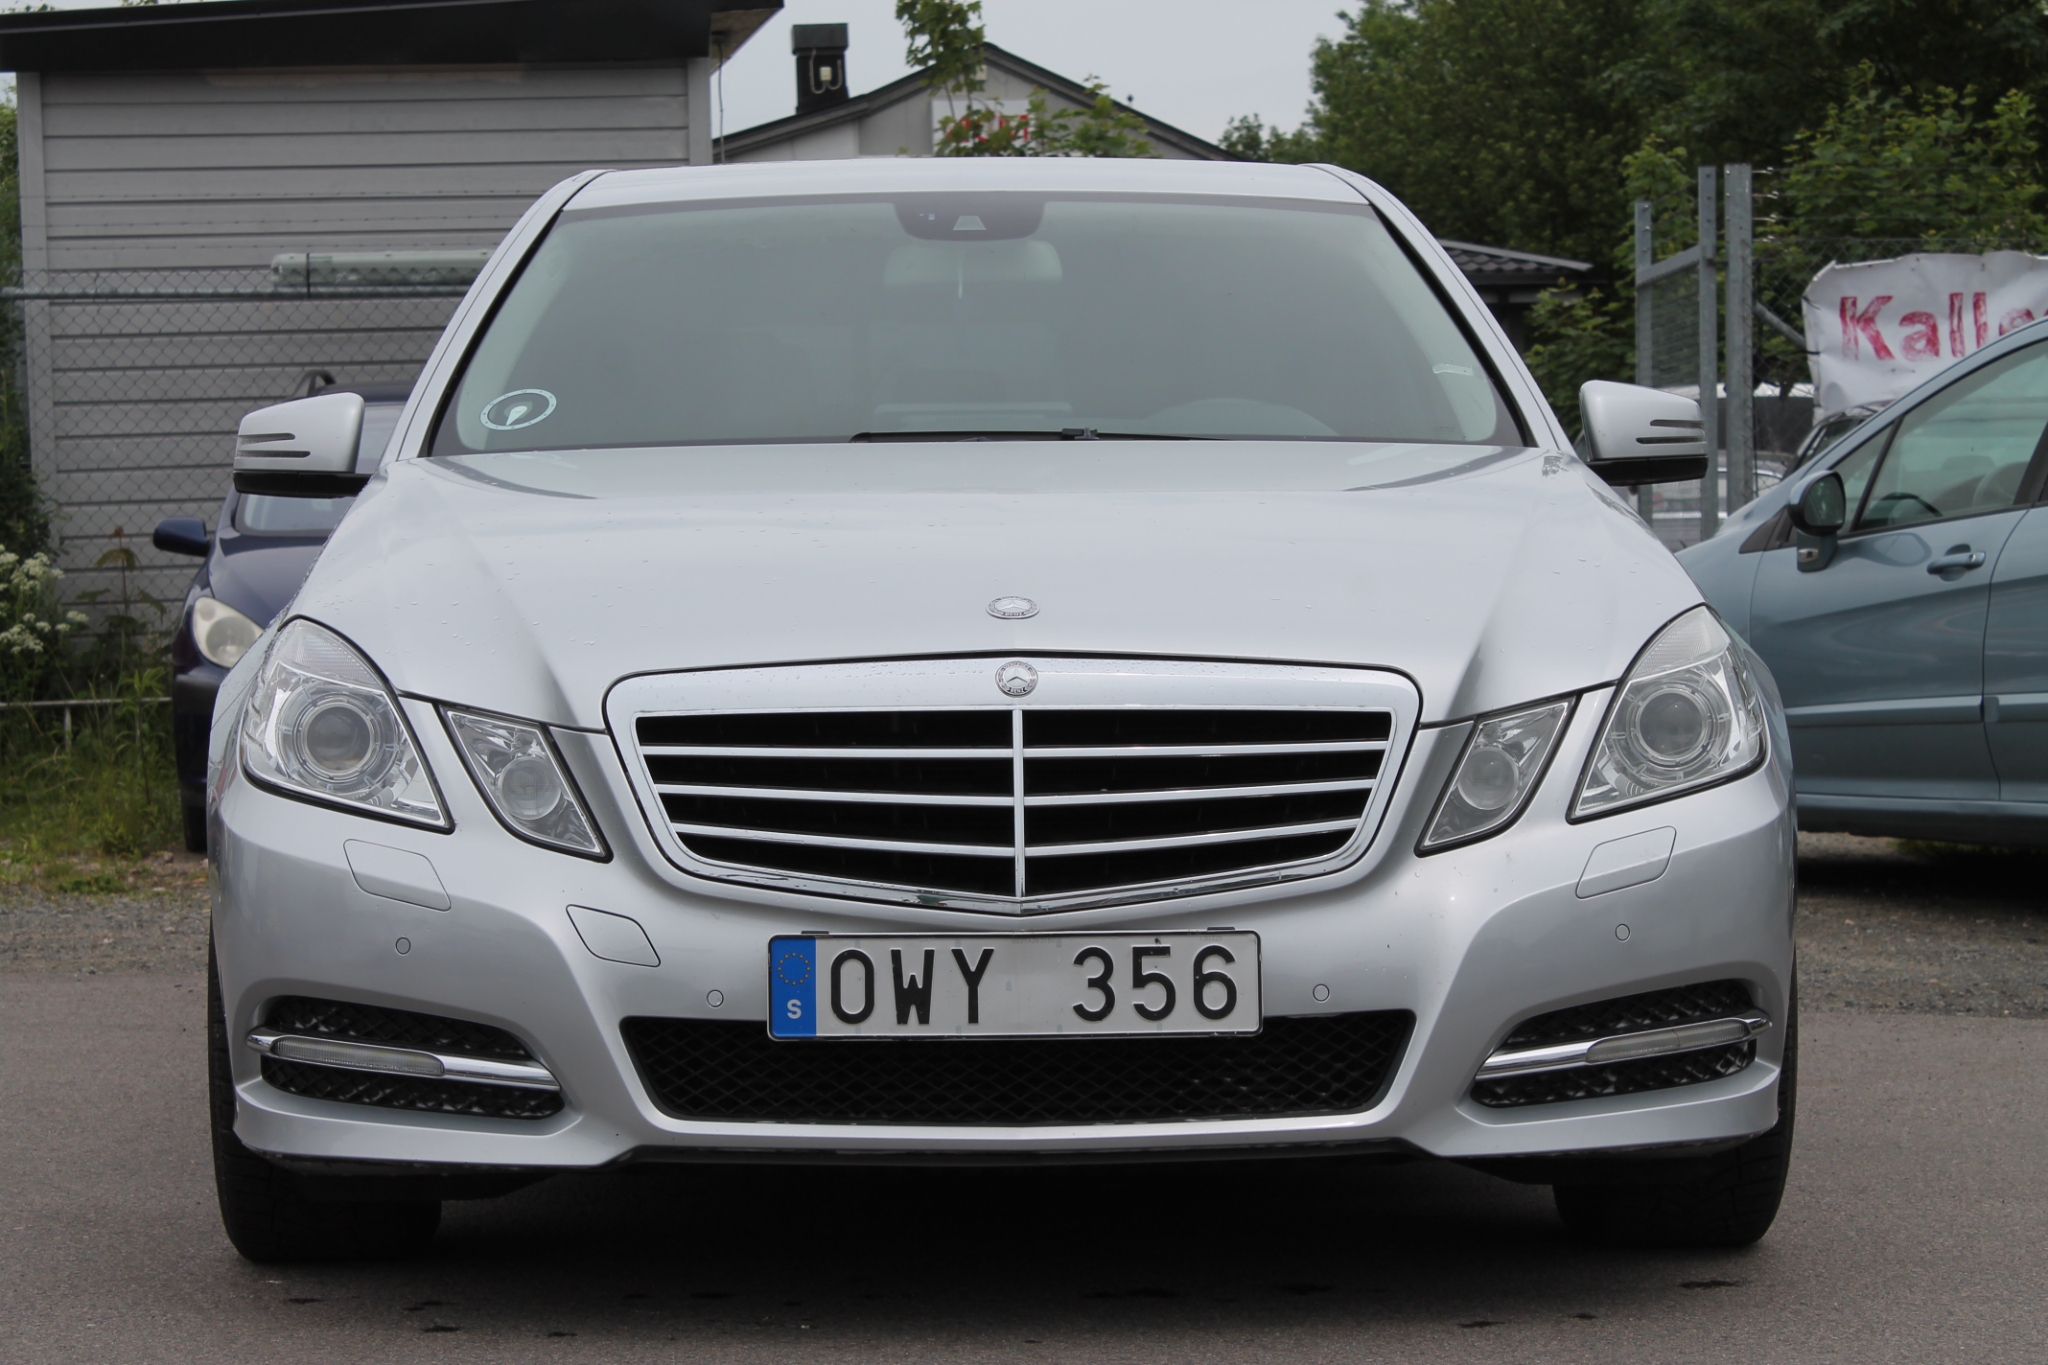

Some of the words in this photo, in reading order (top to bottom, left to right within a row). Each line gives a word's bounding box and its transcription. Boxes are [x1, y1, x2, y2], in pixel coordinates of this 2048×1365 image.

[1839, 291, 2048, 362] Kall
[786, 998, 803, 1020] S
[830, 948, 995, 1025] OWY
[1072, 945, 1238, 1022] 356
